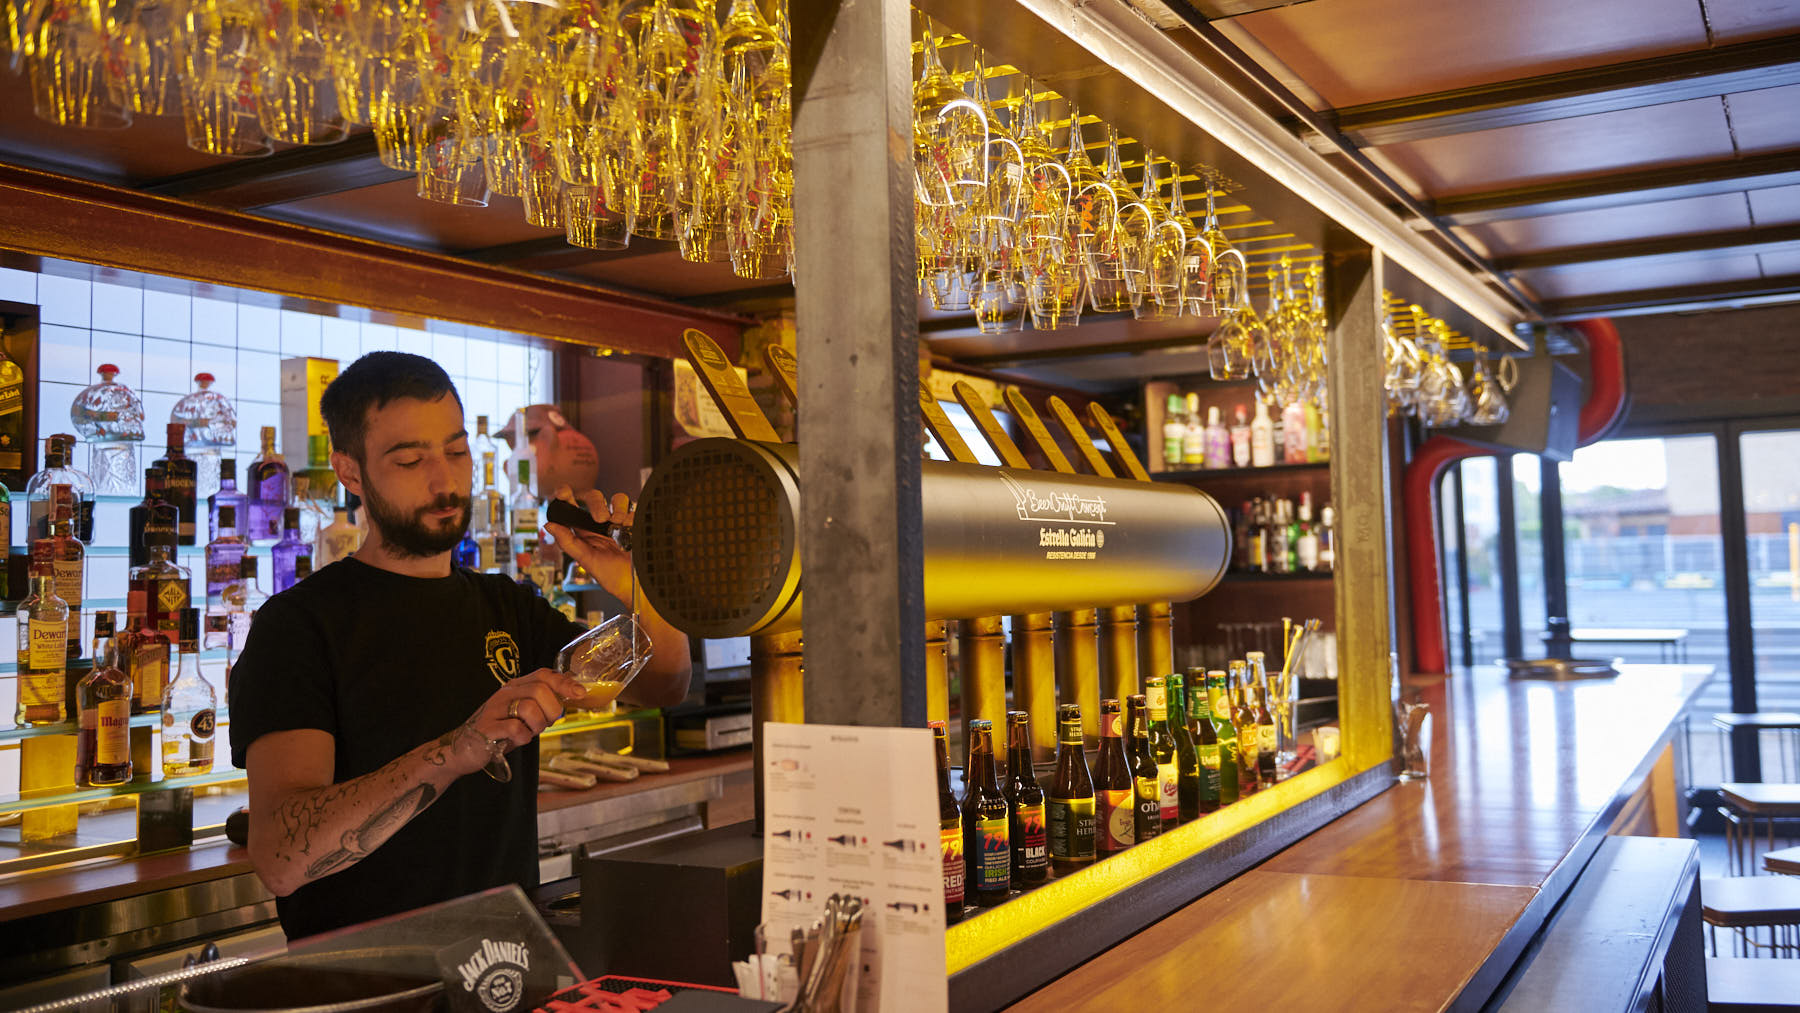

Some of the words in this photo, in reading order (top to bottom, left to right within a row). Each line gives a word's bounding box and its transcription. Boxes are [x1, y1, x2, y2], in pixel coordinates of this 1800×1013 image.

[1039, 527, 1069, 547] Estrella
[1069, 528, 1096, 547] Galicia
[197, 715, 214, 731] 43
[1025, 846, 1045, 858] BLACK
[943, 875, 962, 889] RED
[457, 949, 489, 992] JACK
[481, 938, 530, 972] DANIEL'S
